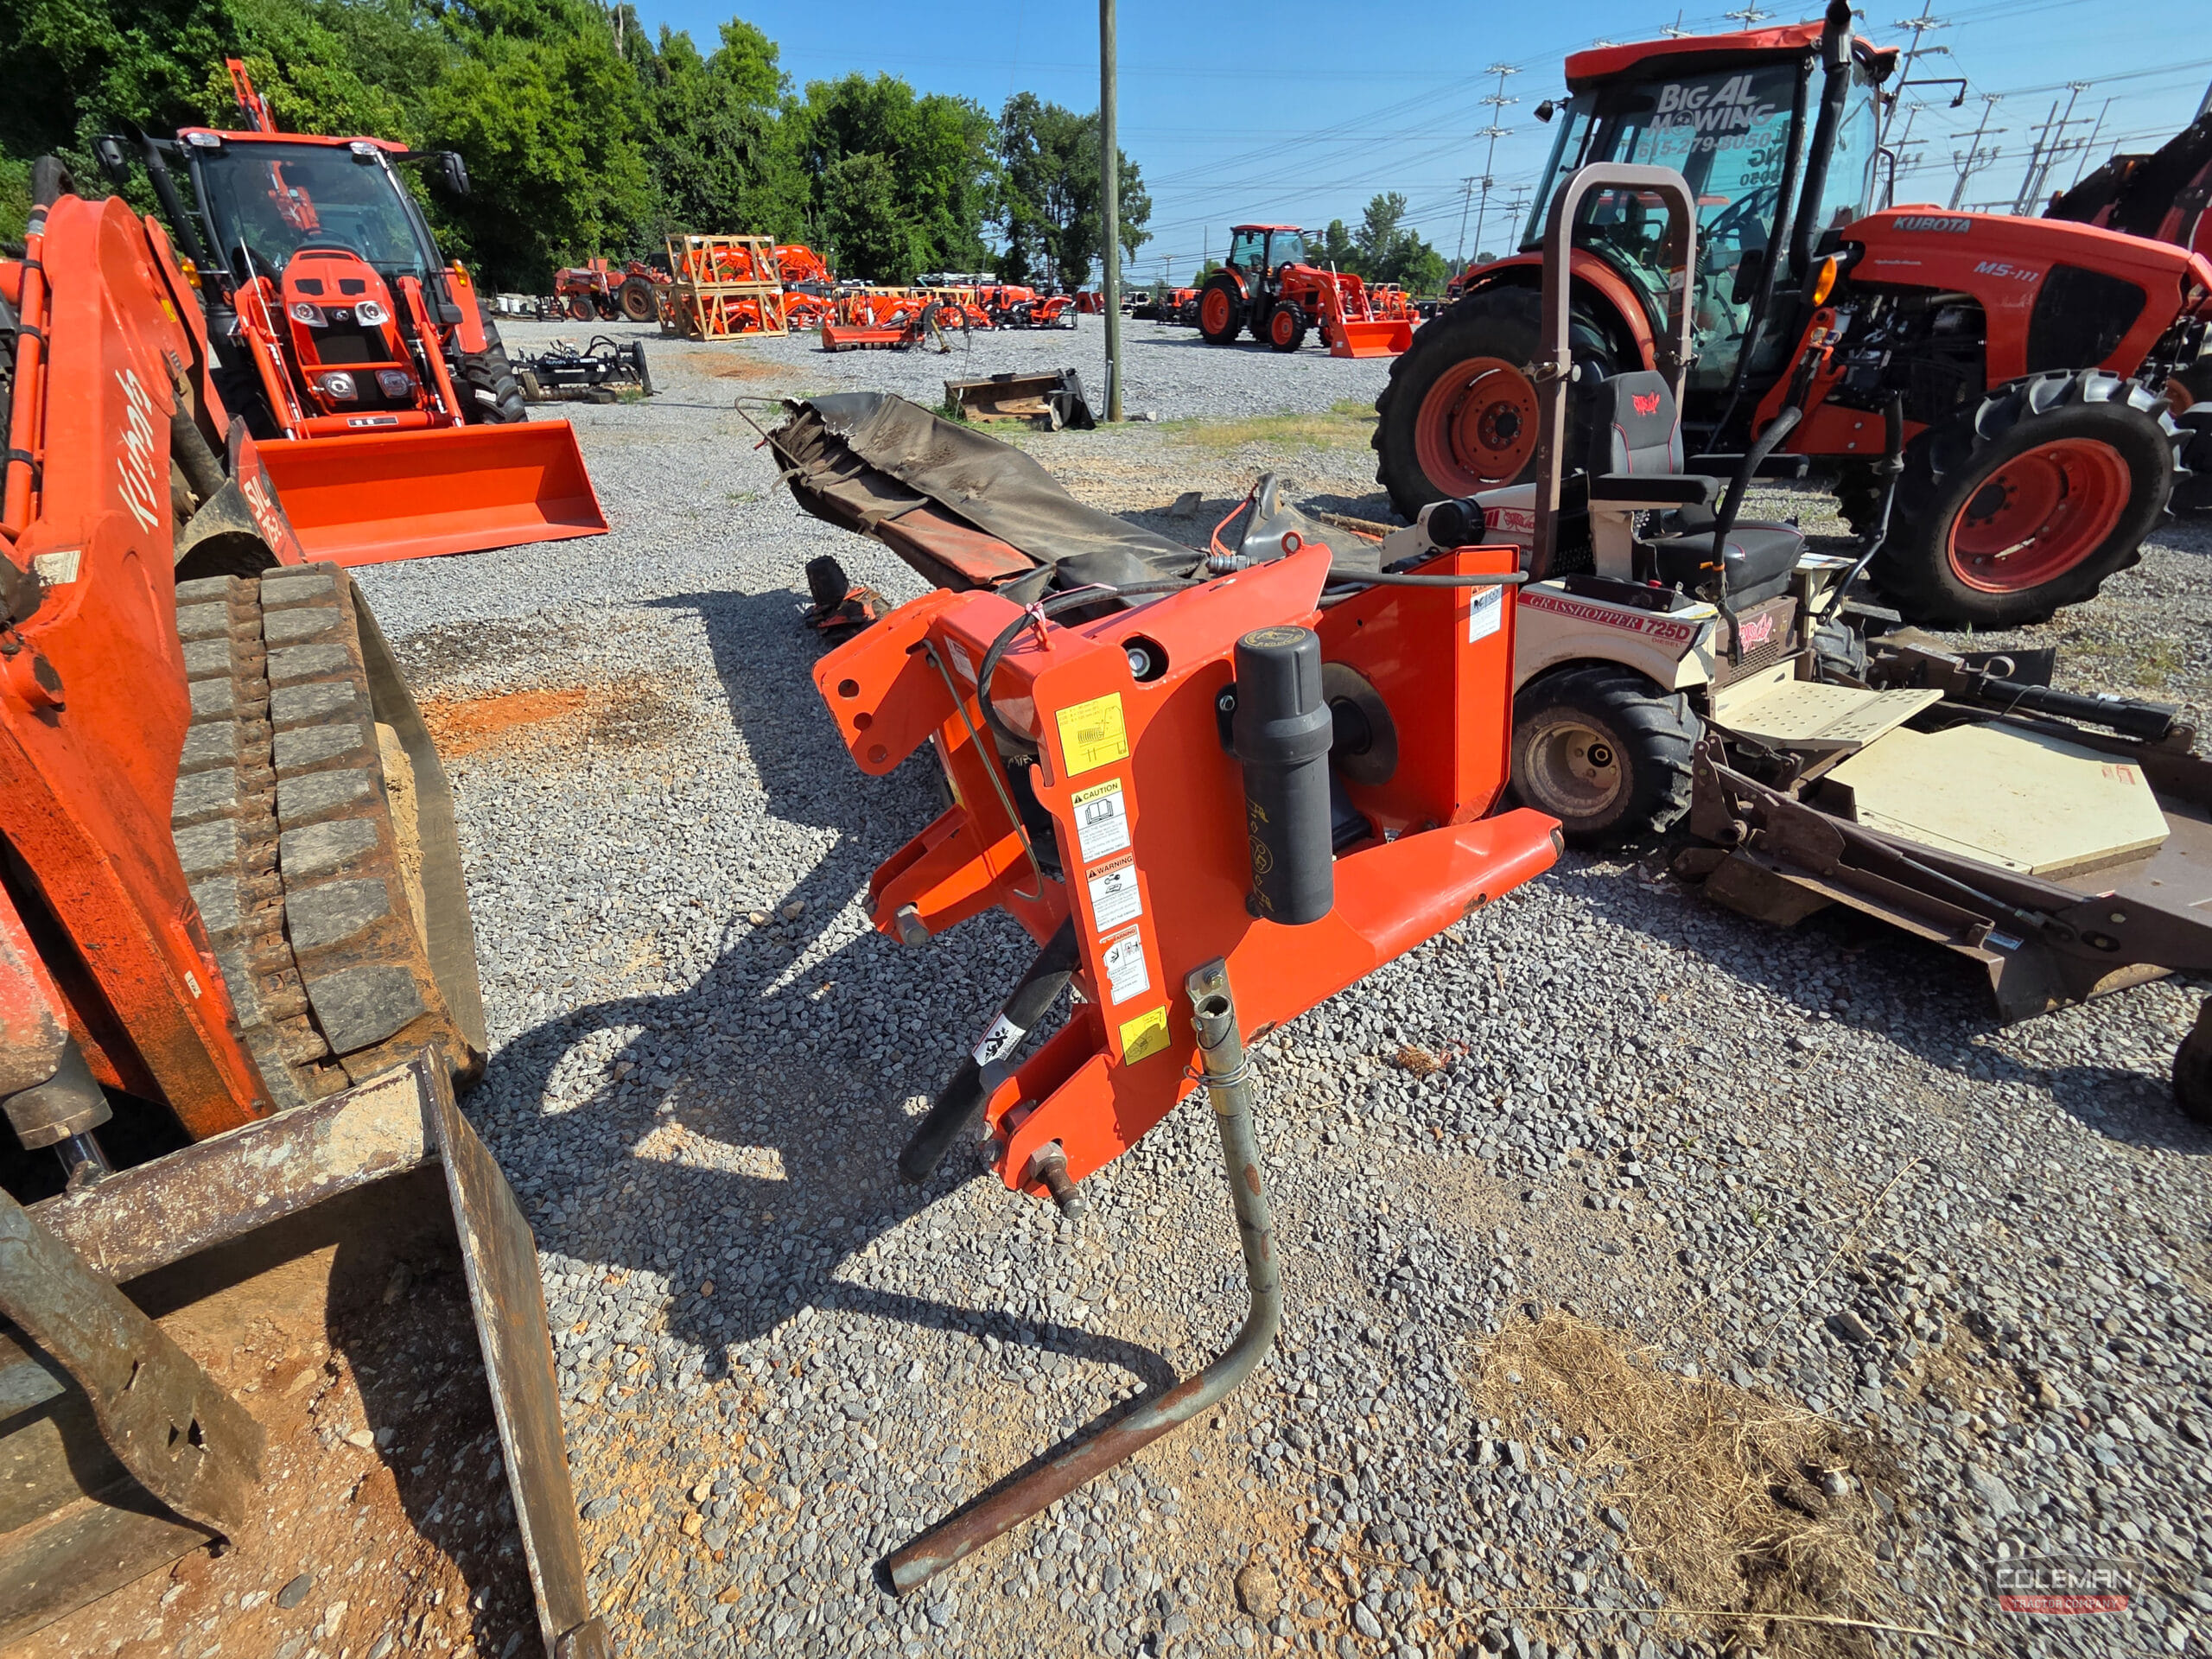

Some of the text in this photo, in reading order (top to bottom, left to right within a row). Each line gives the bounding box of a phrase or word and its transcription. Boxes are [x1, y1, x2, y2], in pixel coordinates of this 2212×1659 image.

[1656, 74, 1761, 114] BIG AL
[1645, 104, 1776, 136] MOWING
[1637, 131, 1772, 159] 615-279-8050
[1892, 216, 1971, 233] KUBOTA
[114, 368, 159, 536] Kubota
[244, 476, 271, 520] SVL
[1529, 595, 1638, 629] GRASSHOPPER
[1645, 620, 1691, 641] 725D
[1651, 637, 1681, 648] DIESEL
[1083, 782, 1118, 800] CAUTION
[1096, 855, 1133, 874] WARNING
[1114, 929, 1135, 942] ARNING
